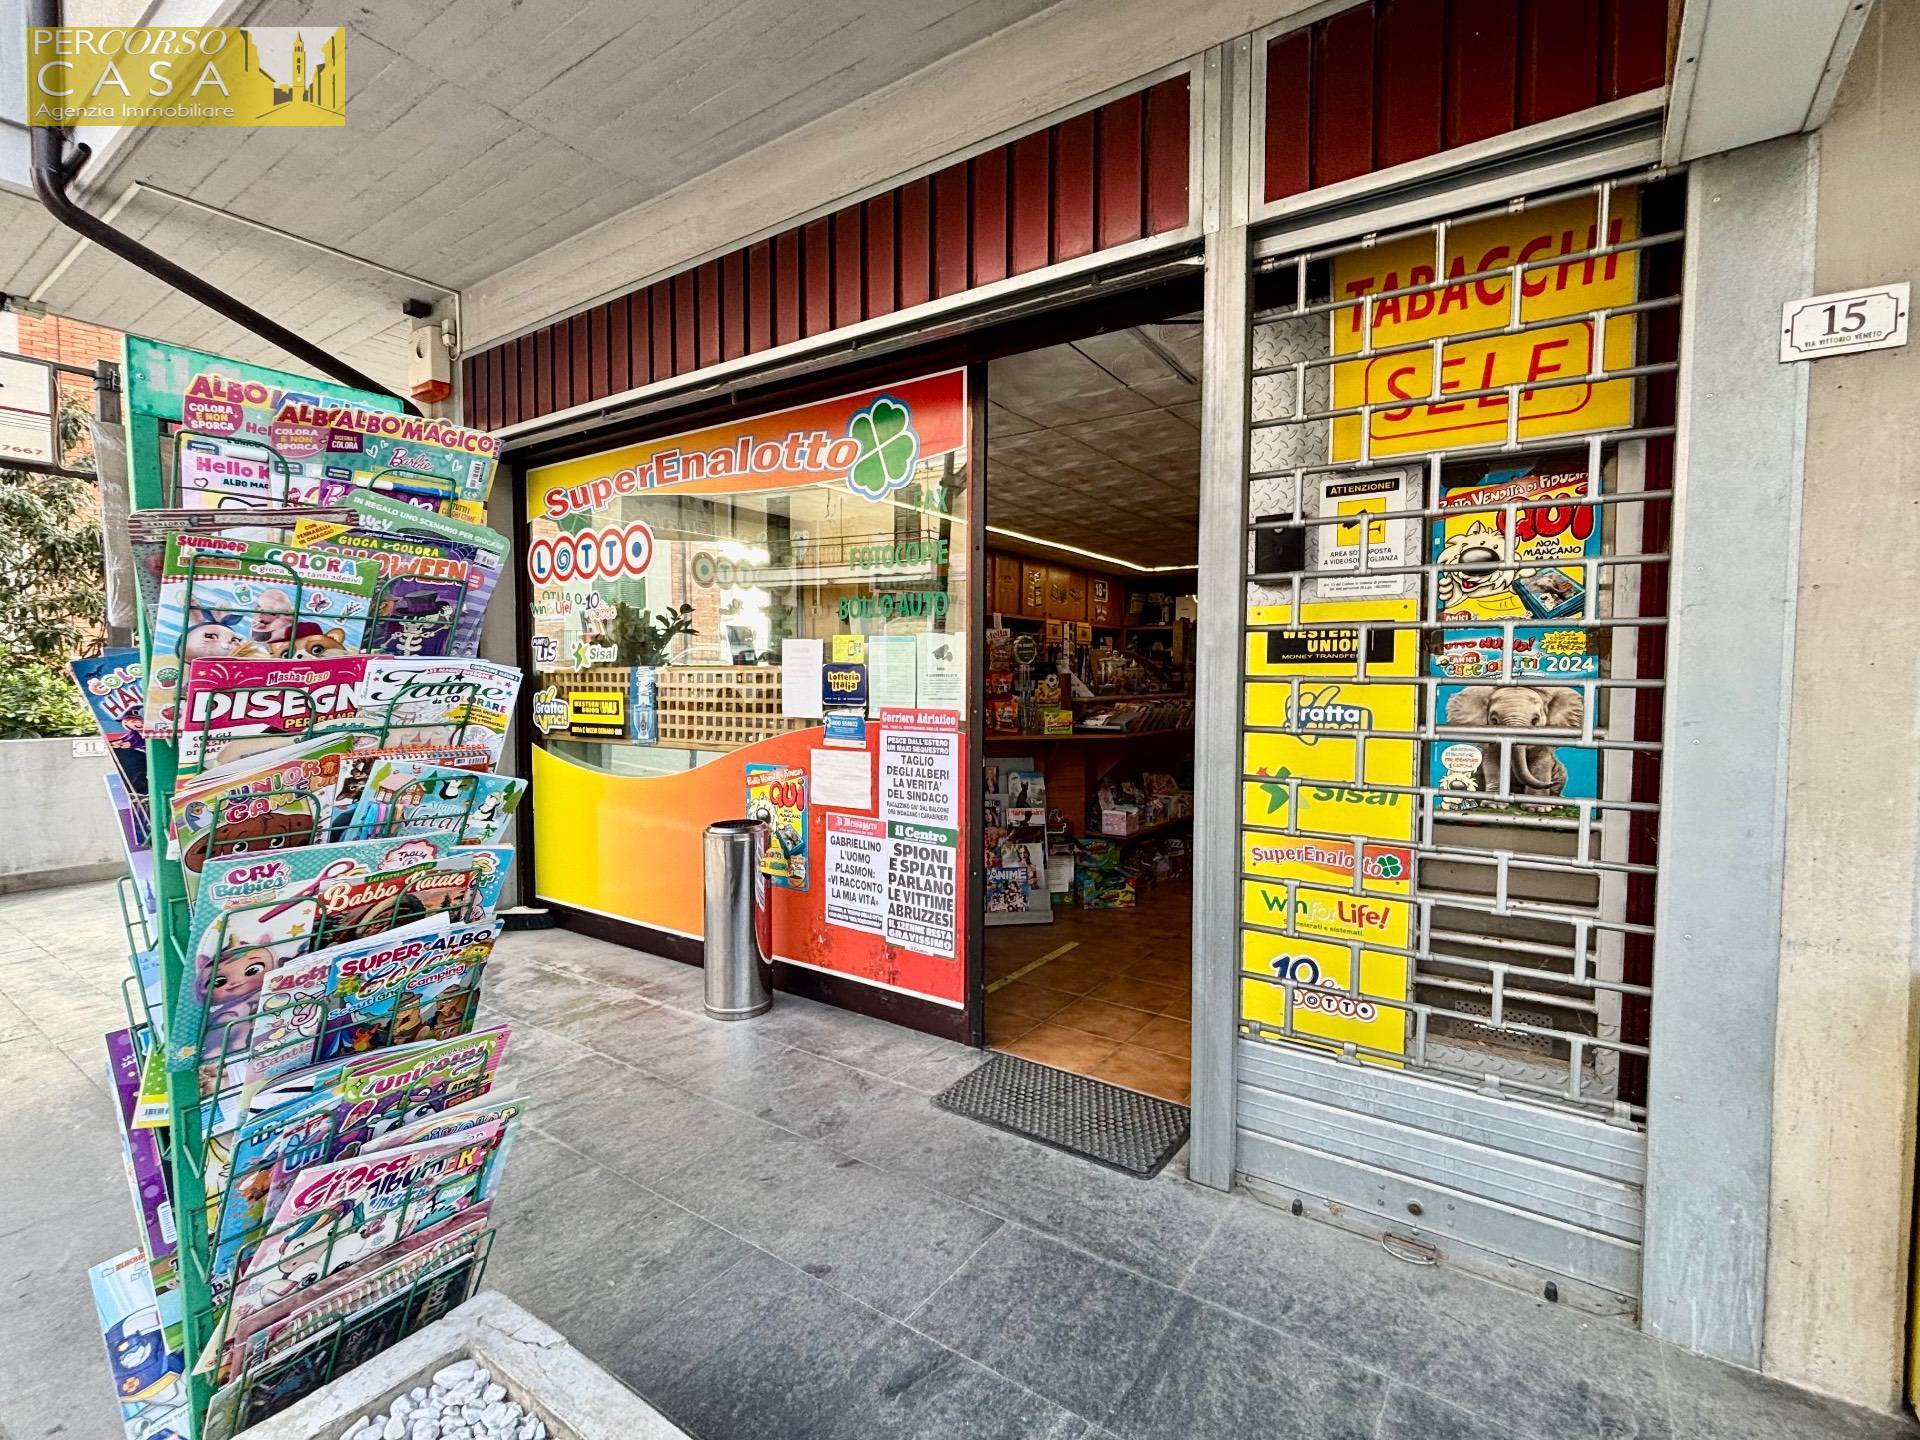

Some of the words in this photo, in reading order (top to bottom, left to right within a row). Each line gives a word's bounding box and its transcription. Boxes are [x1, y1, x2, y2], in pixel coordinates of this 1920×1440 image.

[1346, 218, 1622, 333] TABACCHI
[1821, 299, 1868, 337] 15
[1804, 340, 1816, 348] VIA
[1819, 335, 1852, 345] VITTORIO
[1855, 330, 1883, 340] VENETO
[1383, 339, 1570, 421] SELF
[189, 374, 269, 405] ALBO
[188, 402, 234, 415] COLORA
[190, 420, 235, 432] SPORCA
[205, 413, 229, 423] NON
[274, 427, 320, 437] COLORA
[335, 409, 401, 435] ALBO
[401, 420, 494, 453] MAGICO
[274, 442, 320, 451] SPORCA
[331, 440, 359, 451] COLORA
[196, 456, 254, 478] Hello
[387, 447, 433, 472] Barbie
[223, 478, 248, 488] ALBO
[545, 431, 861, 519] SuperEnalotto
[1329, 481, 1396, 496] ATTENZIONE!
[353, 497, 365, 506] IN
[365, 500, 400, 517] REGALO
[399, 511, 419, 522] UNO
[418, 517, 459, 536] SCENARIO
[458, 528, 474, 540] PER
[338, 536, 379, 550] GIOCA
[392, 542, 440, 558] COLORA
[1522, 545, 1583, 557] MANCANO
[1535, 538, 1561, 547] NON
[264, 547, 357, 577] COLORA
[529, 523, 652, 585] LOTTO
[849, 539, 949, 571] FOTOCOPIE
[1329, 550, 1347, 558] AREA
[1330, 554, 1399, 566] VIDEOSOEGLIANZA
[258, 564, 286, 576] gioca
[306, 571, 330, 581] tanti
[330, 573, 363, 586] adesivi
[838, 595, 893, 621] BOLLO
[897, 591, 949, 618] AUTO
[588, 644, 616, 662] Sisal
[1478, 637, 1536, 653] NUVO!
[1281, 652, 1313, 660] MONEY
[1451, 655, 1478, 664] AMICI
[1545, 656, 1595, 673] 2024
[267, 671, 301, 686] Masha
[305, 670, 331, 685] Orso
[828, 671, 861, 682] Lotteria
[832, 680, 858, 691] Italia
[191, 681, 363, 723] DISEGN
[535, 701, 565, 715] Gratta
[881, 711, 915, 723] Corriere
[916, 712, 956, 726] Adriatico
[84, 742, 97, 752] 11
[888, 737, 907, 745] PESCE
[907, 737, 949, 747] DALL'ESTERO
[896, 745, 912, 753] MAXI
[912, 745, 949, 755] SEQUESTRO
[901, 754, 935, 767] TAGLIO
[886, 765, 914, 776] DEGLI
[915, 767, 950, 780] ALBERI
[893, 777, 905, 789] LA
[906, 778, 942, 792] VERITA'
[887, 788, 905, 800] DEL
[906, 790, 949, 804] SINDACO
[904, 826, 948, 843] Centro
[830, 834, 882, 853] GABRIELLINO
[840, 849, 871, 865] L'UOMO
[893, 842, 949, 865] SPIONI
[1251, 846, 1384, 878] SuperEnaloto
[227, 861, 286, 886] CRY
[835, 862, 876, 879] PLASMON:
[889, 857, 898, 871] E
[900, 858, 953, 881] SPIATI
[988, 867, 1027, 880] ANIME
[212, 875, 286, 899] Babies
[324, 882, 401, 914] Babbo
[404, 869, 468, 892] Natale
[839, 876, 883, 894] RACCONTO
[888, 871, 954, 896] PARLANO
[831, 887, 843, 899] LA
[842, 889, 857, 903] MIA
[888, 886, 903, 902] LE
[902, 888, 954, 912] VITTIME
[887, 902, 953, 929] ABRUZZESI
[1260, 888, 1308, 915] Wn
[1337, 900, 1391, 930] Life!
[888, 928, 953, 951] GRAVISSIMO
[926, 924, 953, 941] RESTA
[339, 942, 424, 979] SUPER
[430, 929, 492, 952] ALBO
[1272, 955, 1320, 985] 10
